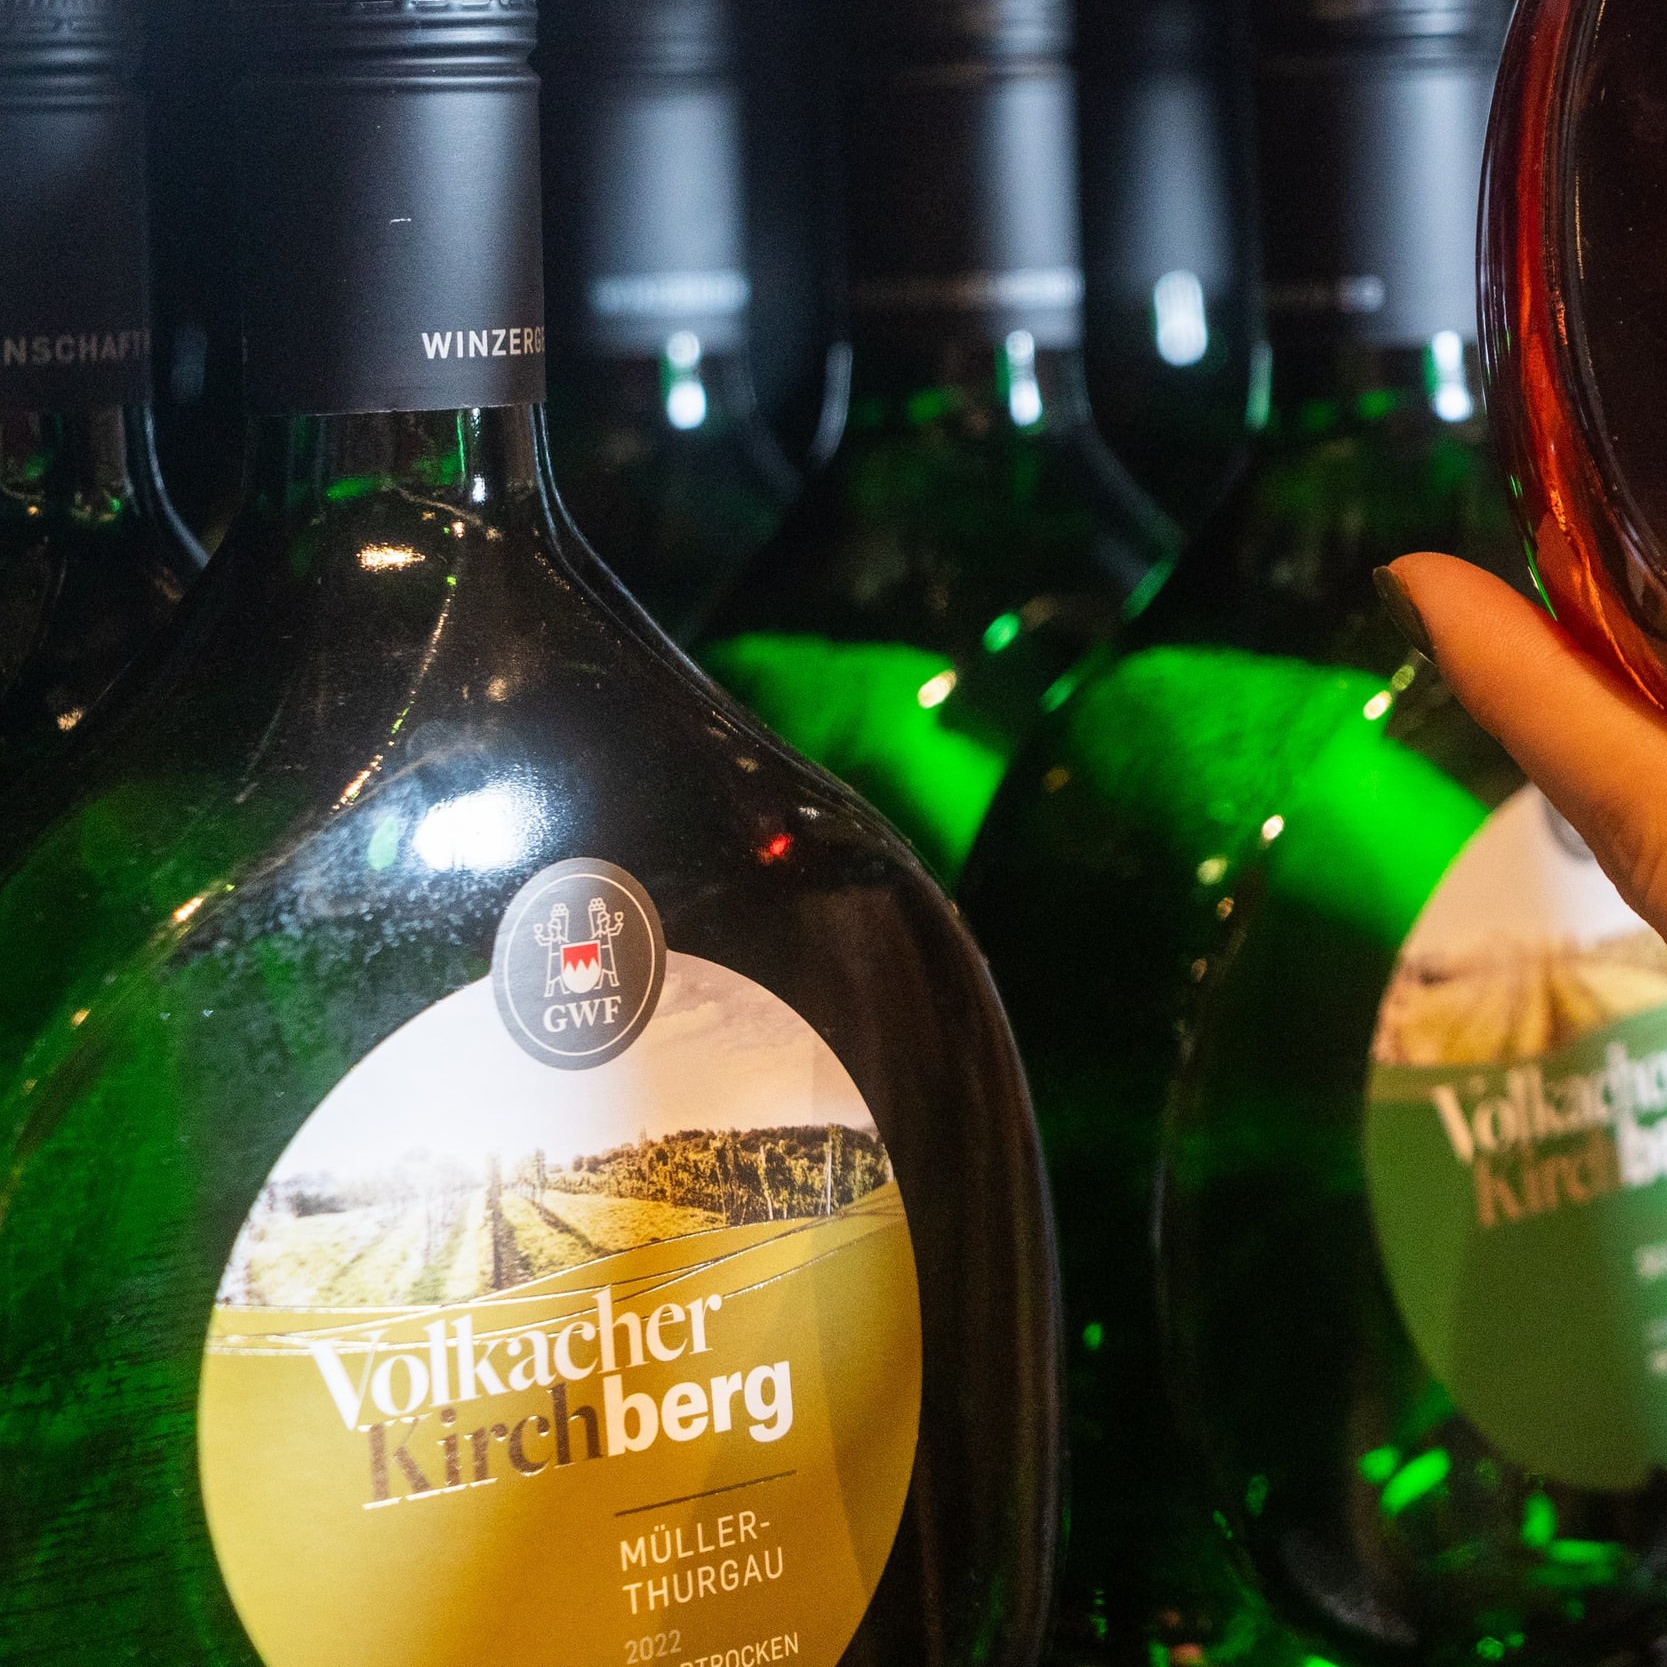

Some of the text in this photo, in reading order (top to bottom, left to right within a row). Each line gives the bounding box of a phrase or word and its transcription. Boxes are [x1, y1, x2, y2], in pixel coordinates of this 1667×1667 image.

[543, 995, 622, 1033] GWF
[309, 1284, 723, 1432] Volkacher
[357, 1360, 795, 1511] Kirchberg
[620, 1510, 770, 1572] MÜLLER-
[622, 1546, 783, 1615] THURGAU
[625, 1629, 682, 1665] 2022
[680, 1632, 799, 1667] ROCKEN
